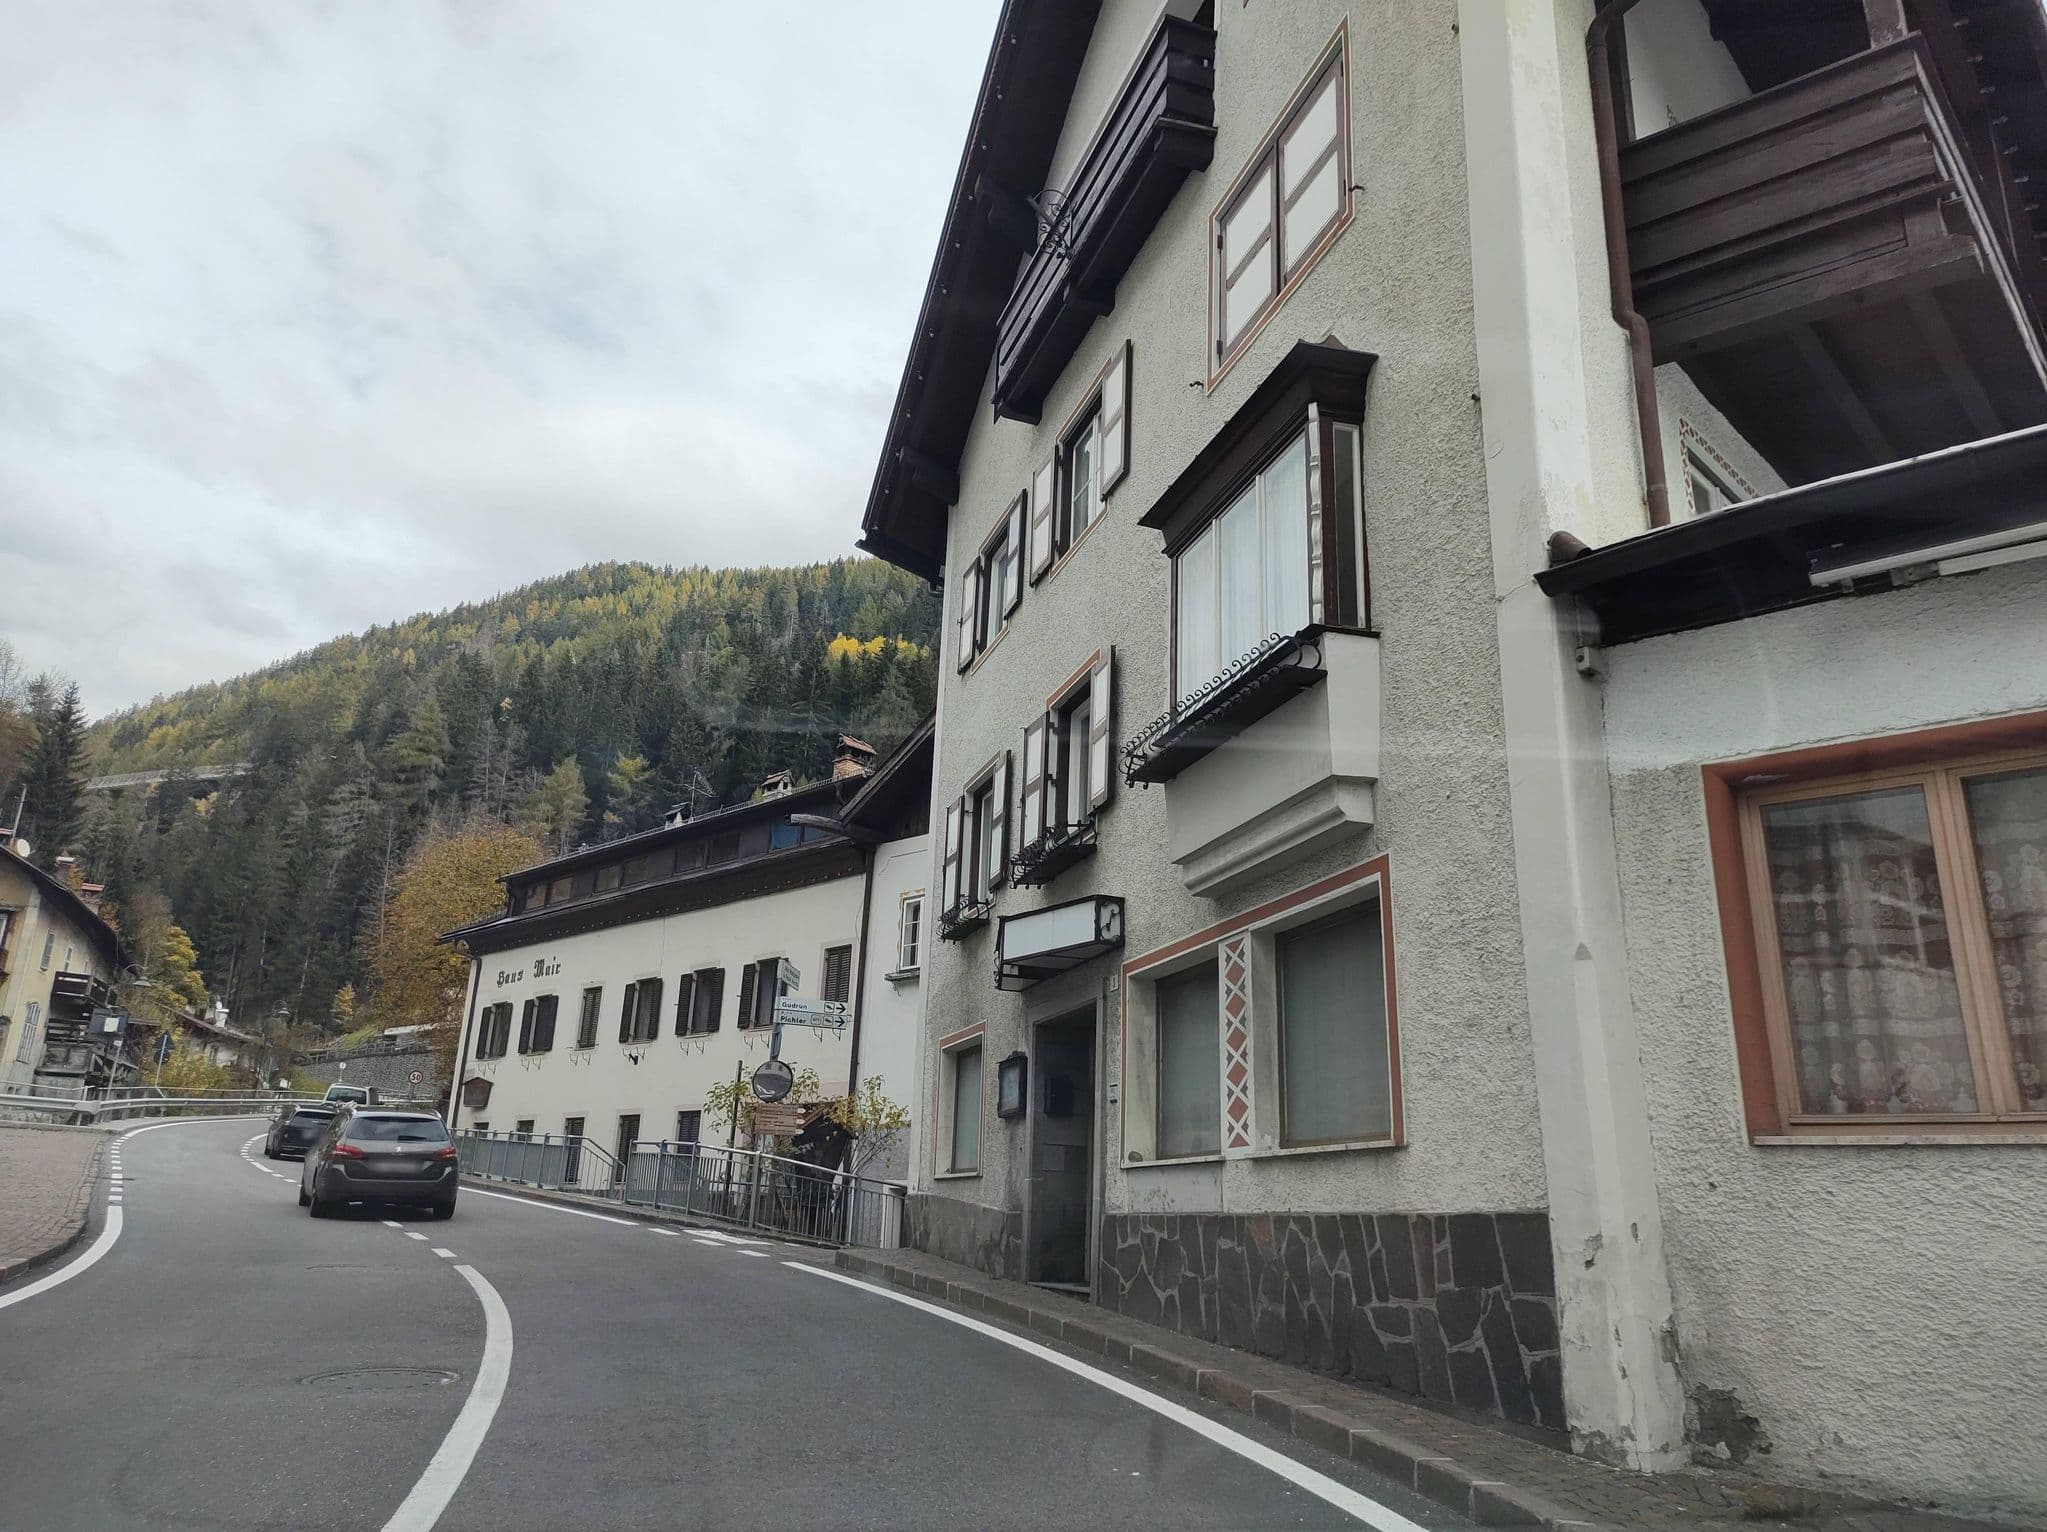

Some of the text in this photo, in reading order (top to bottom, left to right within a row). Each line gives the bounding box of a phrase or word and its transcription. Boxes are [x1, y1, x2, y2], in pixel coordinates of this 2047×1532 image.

[534, 956, 561, 978] Mair
[781, 1001, 808, 1010] Gudrun
[780, 1015, 807, 1024] Pichler
[411, 1073, 421, 1082] 50
